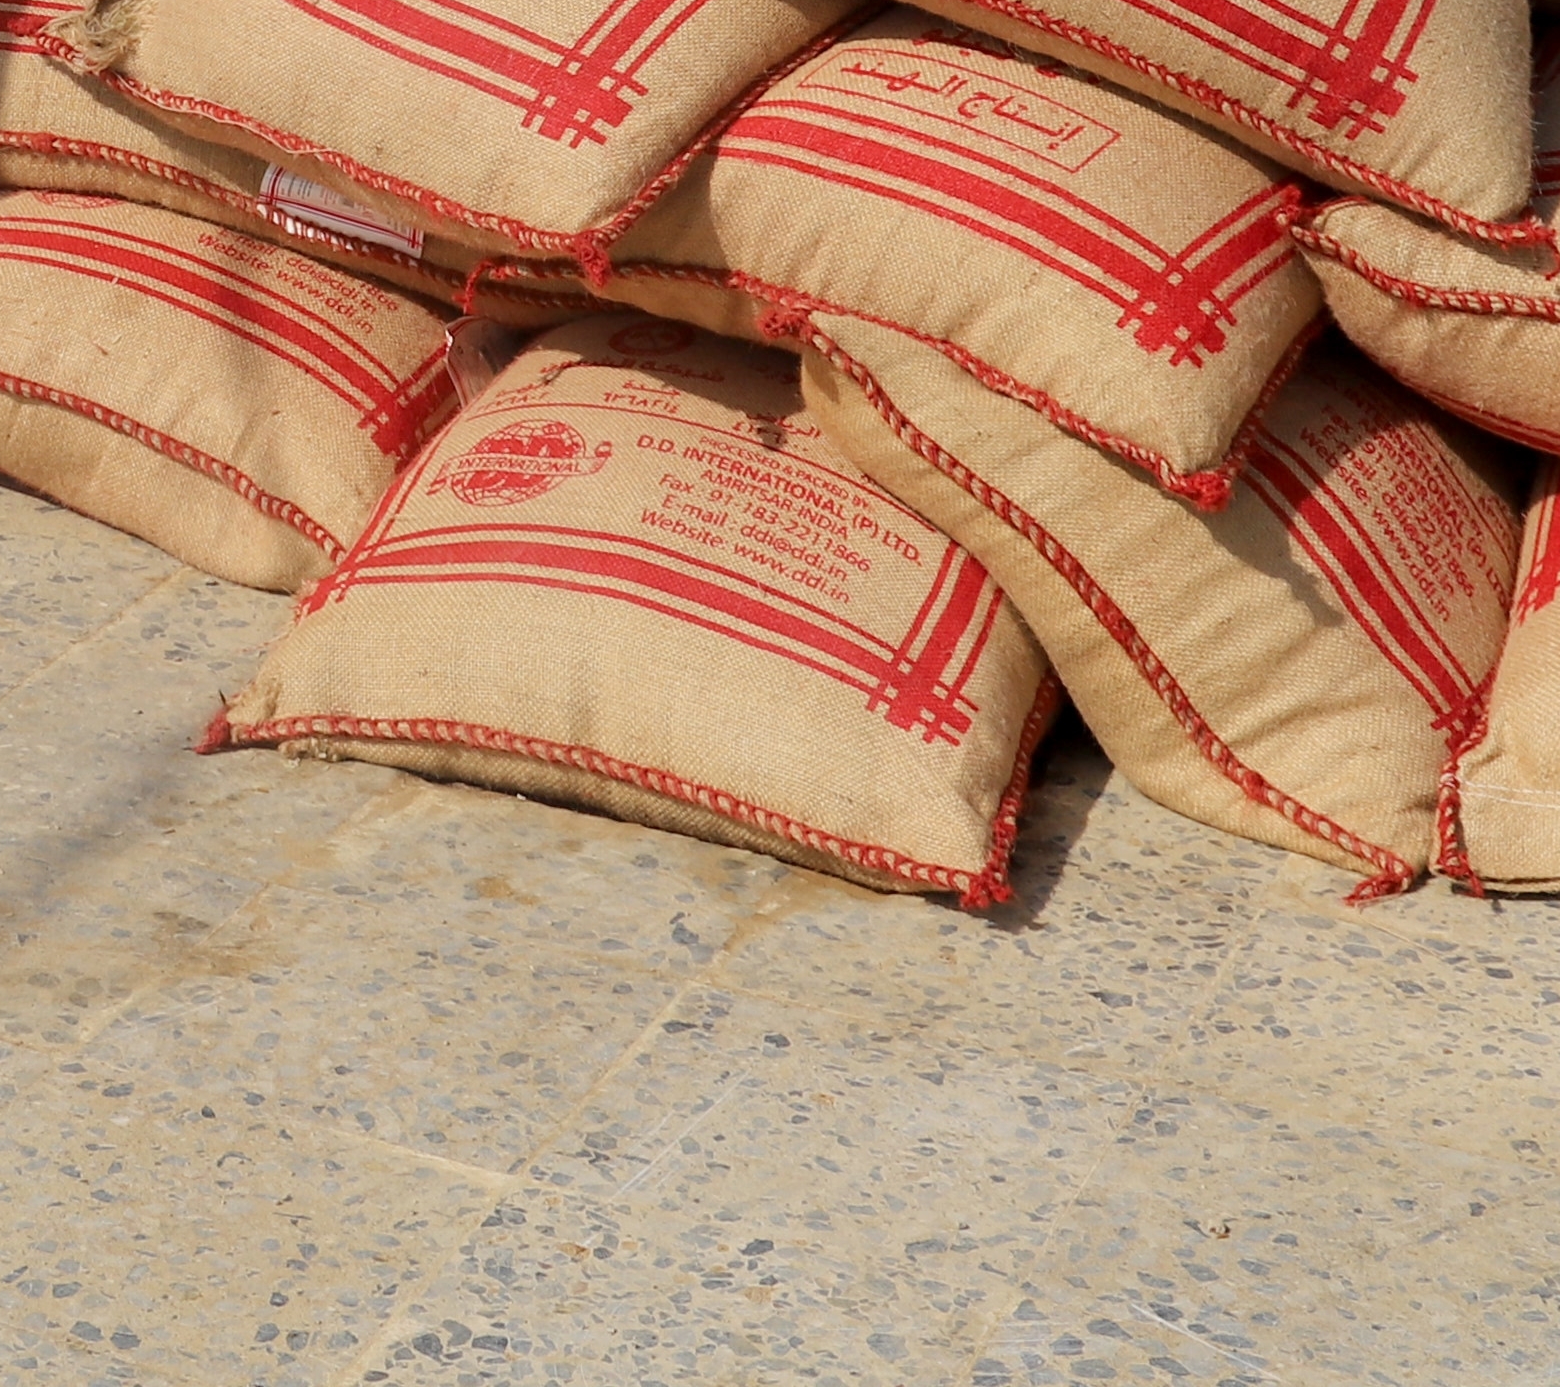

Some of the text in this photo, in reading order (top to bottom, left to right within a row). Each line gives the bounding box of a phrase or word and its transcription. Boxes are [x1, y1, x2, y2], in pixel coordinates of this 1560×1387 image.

[839, 60, 1089, 153] إنتاج الهند
[196, 230, 376, 337] Website: www.ddi.in
[456, 456, 582, 472] INTERNATIONAL
[634, 432, 927, 569] D.D. INTERNATIONAL (P) LTD.
[697, 435, 782, 471] PROCESSED
[793, 468, 850, 501] PACKED
[699, 466, 851, 541] AMRITSAR-INDIA
[639, 506, 851, 606] Website: www.ddi.in
[657, 473, 874, 574] Fax 91-183-2211866
[660, 493, 850, 583] E-mail ddi@ddi.in
[1297, 425, 1372, 507] Website:
[1368, 505, 1454, 623] www.ddi.in
[1362, 442, 1479, 600] 91-183-2211866
[1378, 486, 1458, 599] ddi@ddi.in
